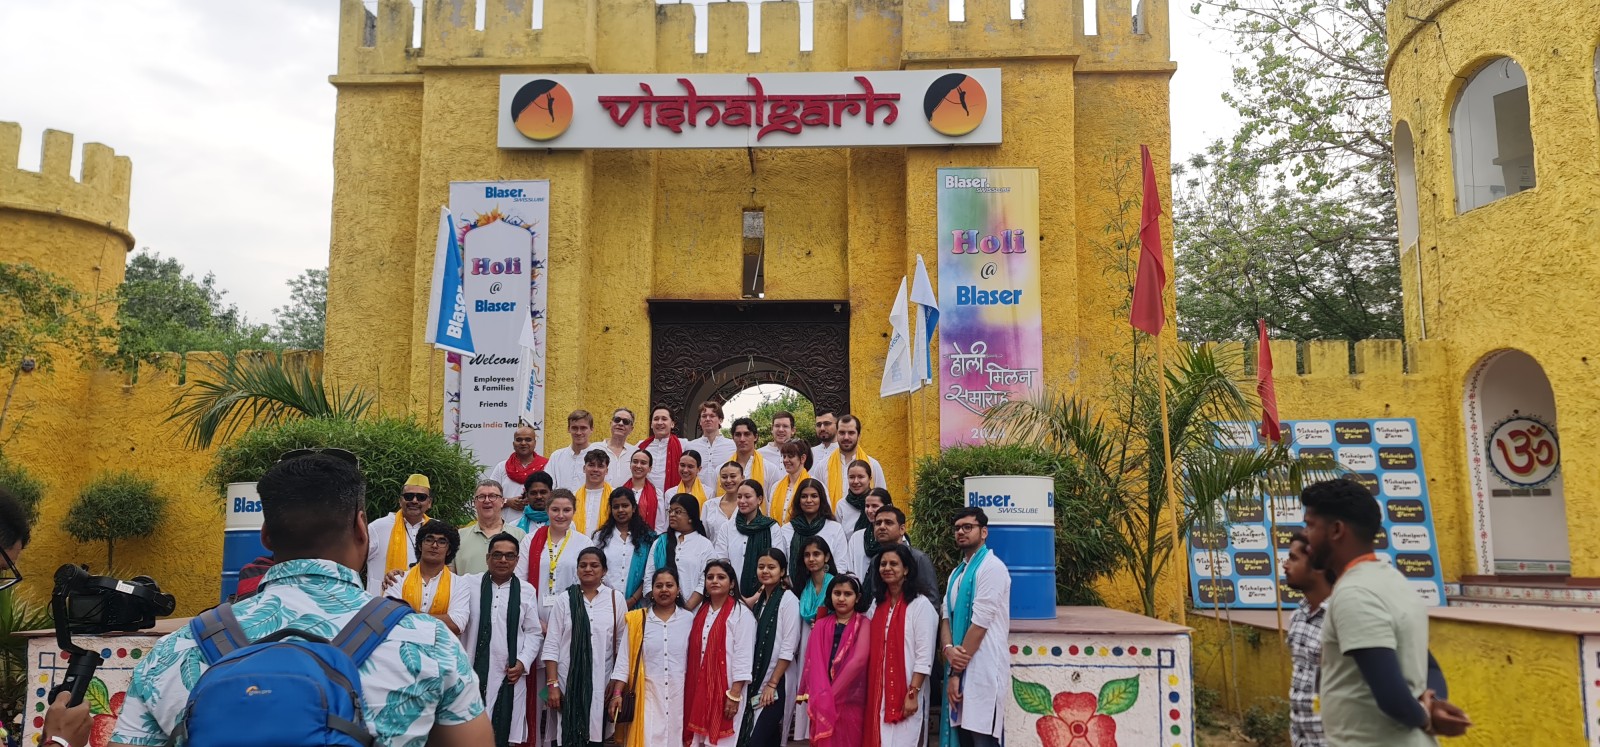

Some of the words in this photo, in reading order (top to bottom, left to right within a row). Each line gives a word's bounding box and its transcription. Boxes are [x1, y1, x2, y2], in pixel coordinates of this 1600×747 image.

[945, 175, 990, 188] Blaser.
[485, 186, 526, 198] Blaser.
[951, 229, 1026, 254] Holi
[471, 257, 522, 276] Holi
[981, 262, 997, 279] @
[490, 282, 502, 294] @
[956, 286, 1022, 305] Blaser
[475, 300, 516, 312] Blaser
[469, 354, 520, 365] Welcom
[950, 341, 987, 377] होली
[984, 362, 1038, 387] मिलन
[234, 497, 262, 512] Blas
[969, 492, 1015, 508] Blaser.
